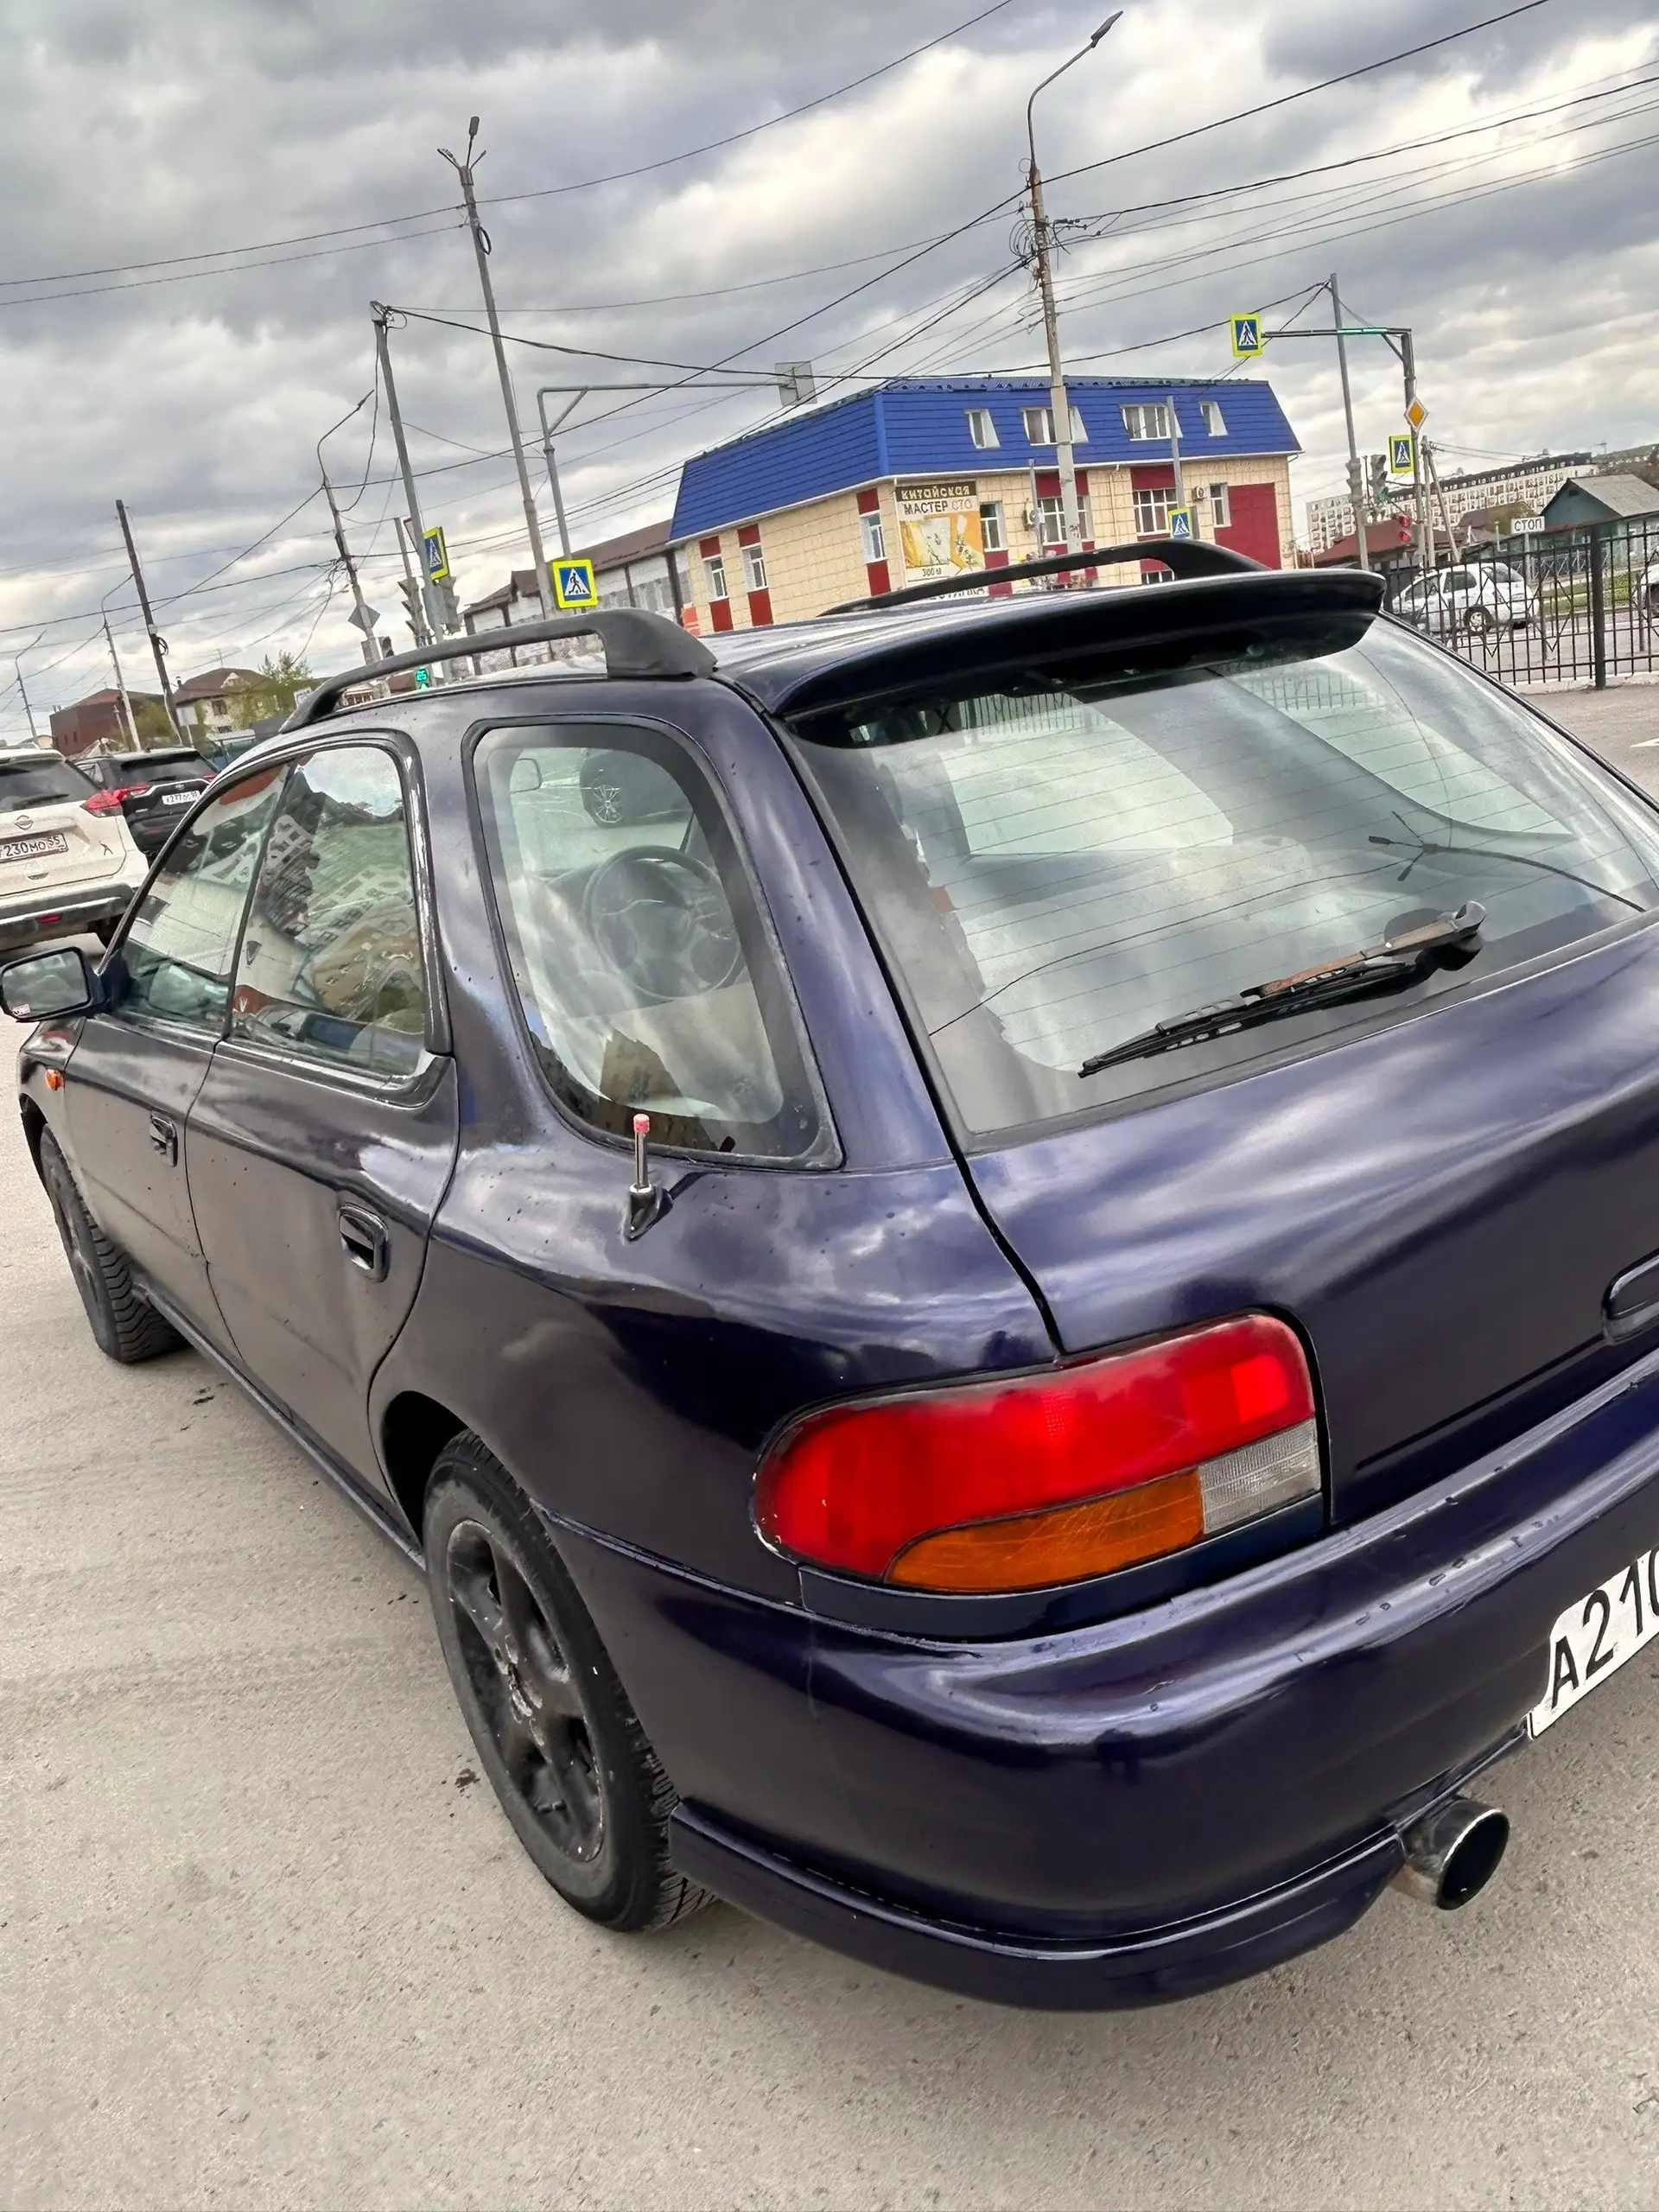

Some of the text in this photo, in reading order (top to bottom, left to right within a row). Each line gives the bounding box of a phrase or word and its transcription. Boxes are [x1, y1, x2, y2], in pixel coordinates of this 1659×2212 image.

[903, 500, 948, 515] МАСТЕР
[1514, 518, 1542, 531] СТОП
[0, 842, 46, 857] 230МО
